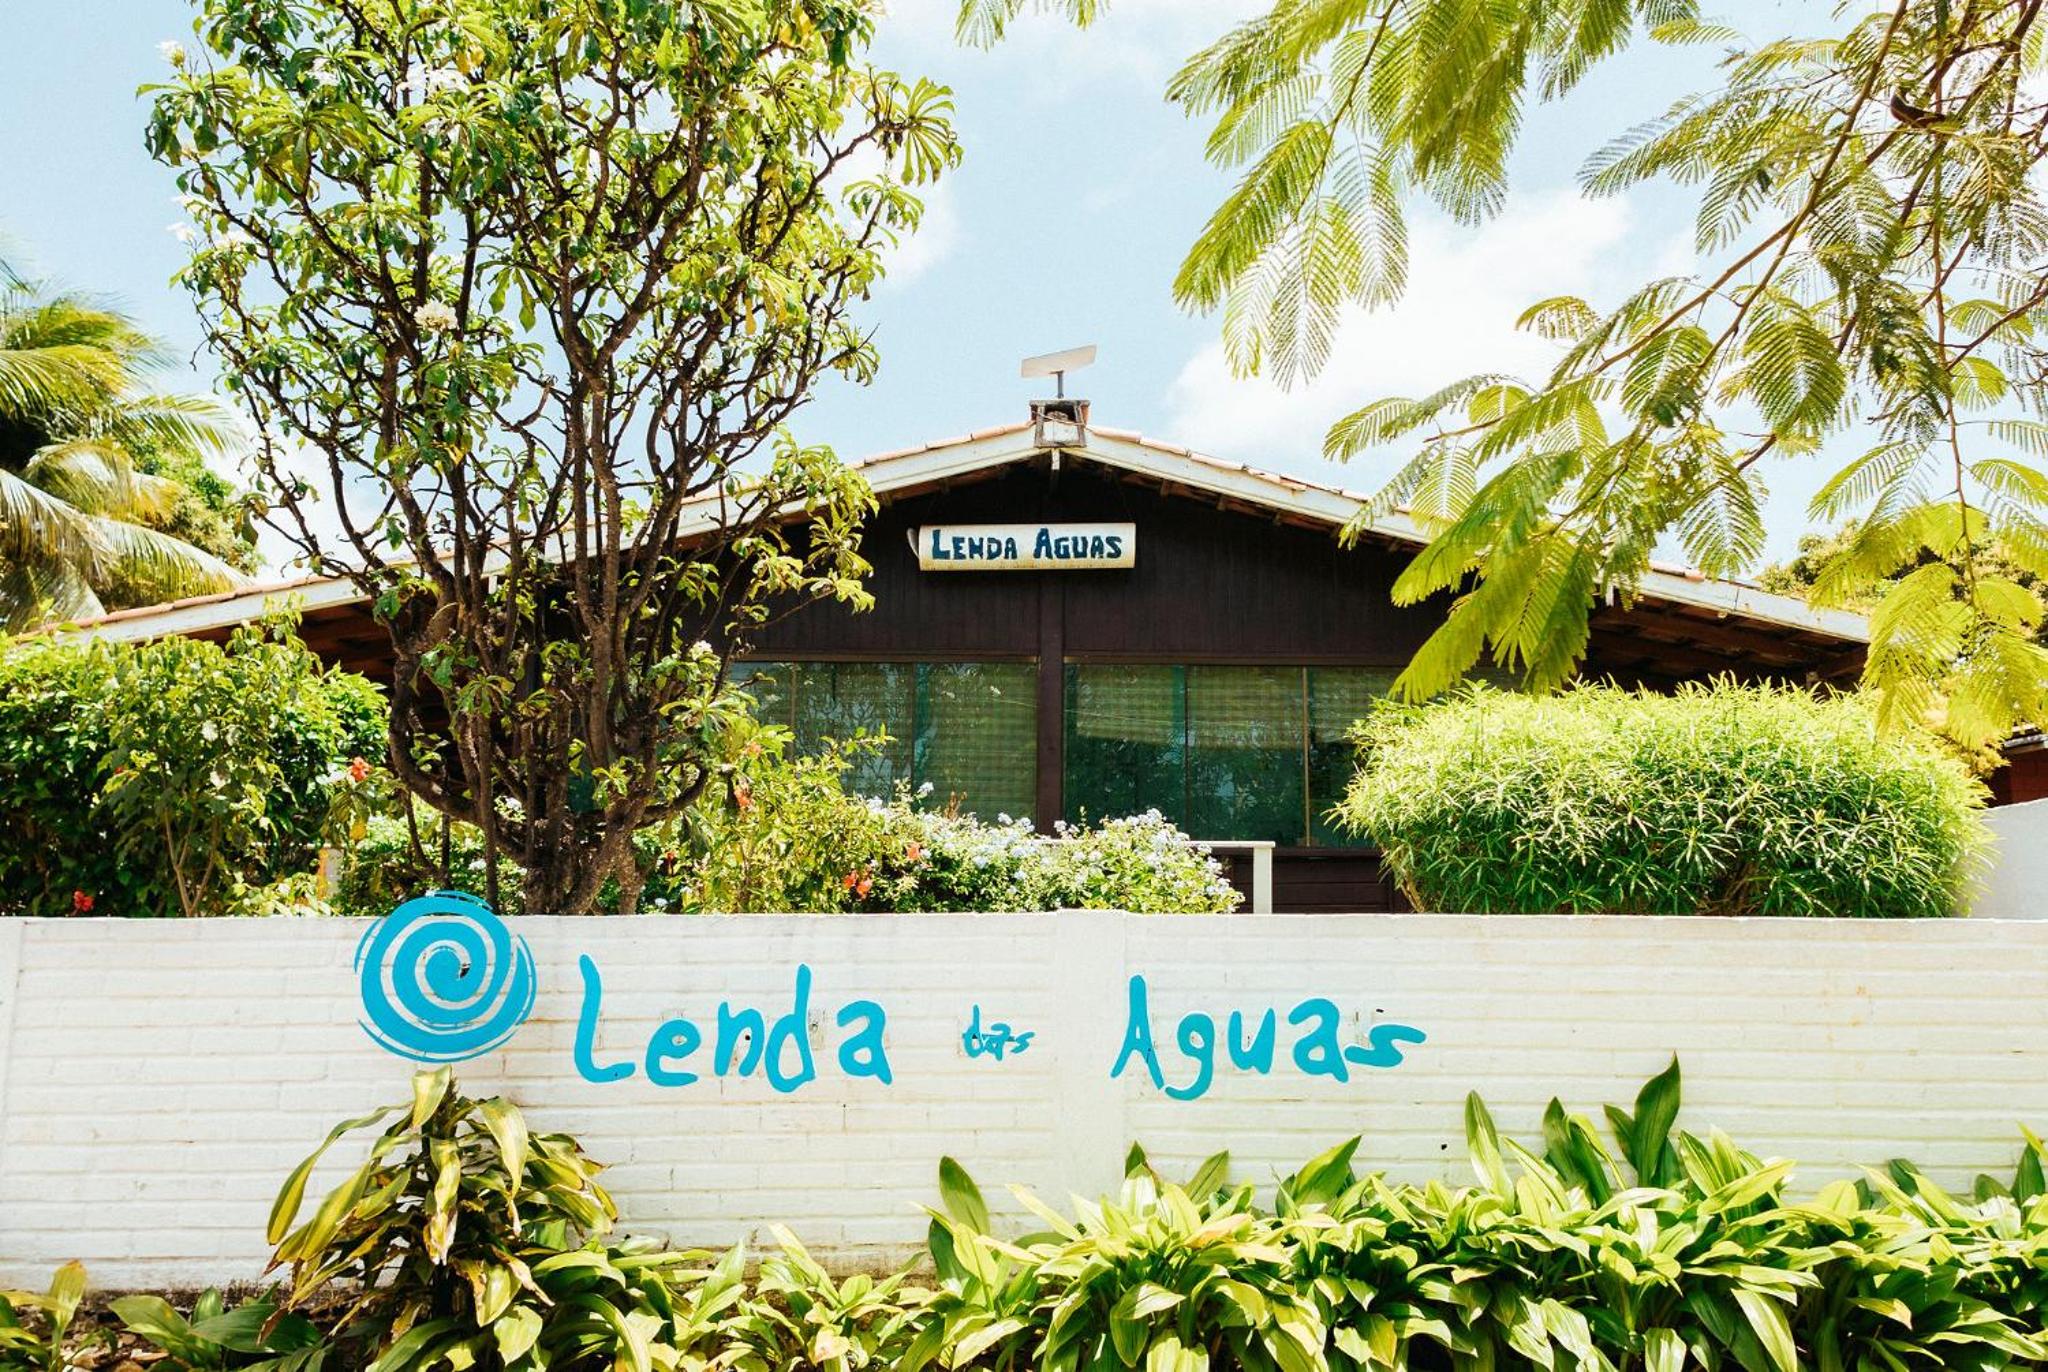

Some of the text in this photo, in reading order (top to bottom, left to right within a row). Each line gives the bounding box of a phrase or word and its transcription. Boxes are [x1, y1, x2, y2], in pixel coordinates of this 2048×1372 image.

[931, 527, 1123, 561] LENDA AGUAS
[573, 954, 1426, 1101] Lenda das Aguas
